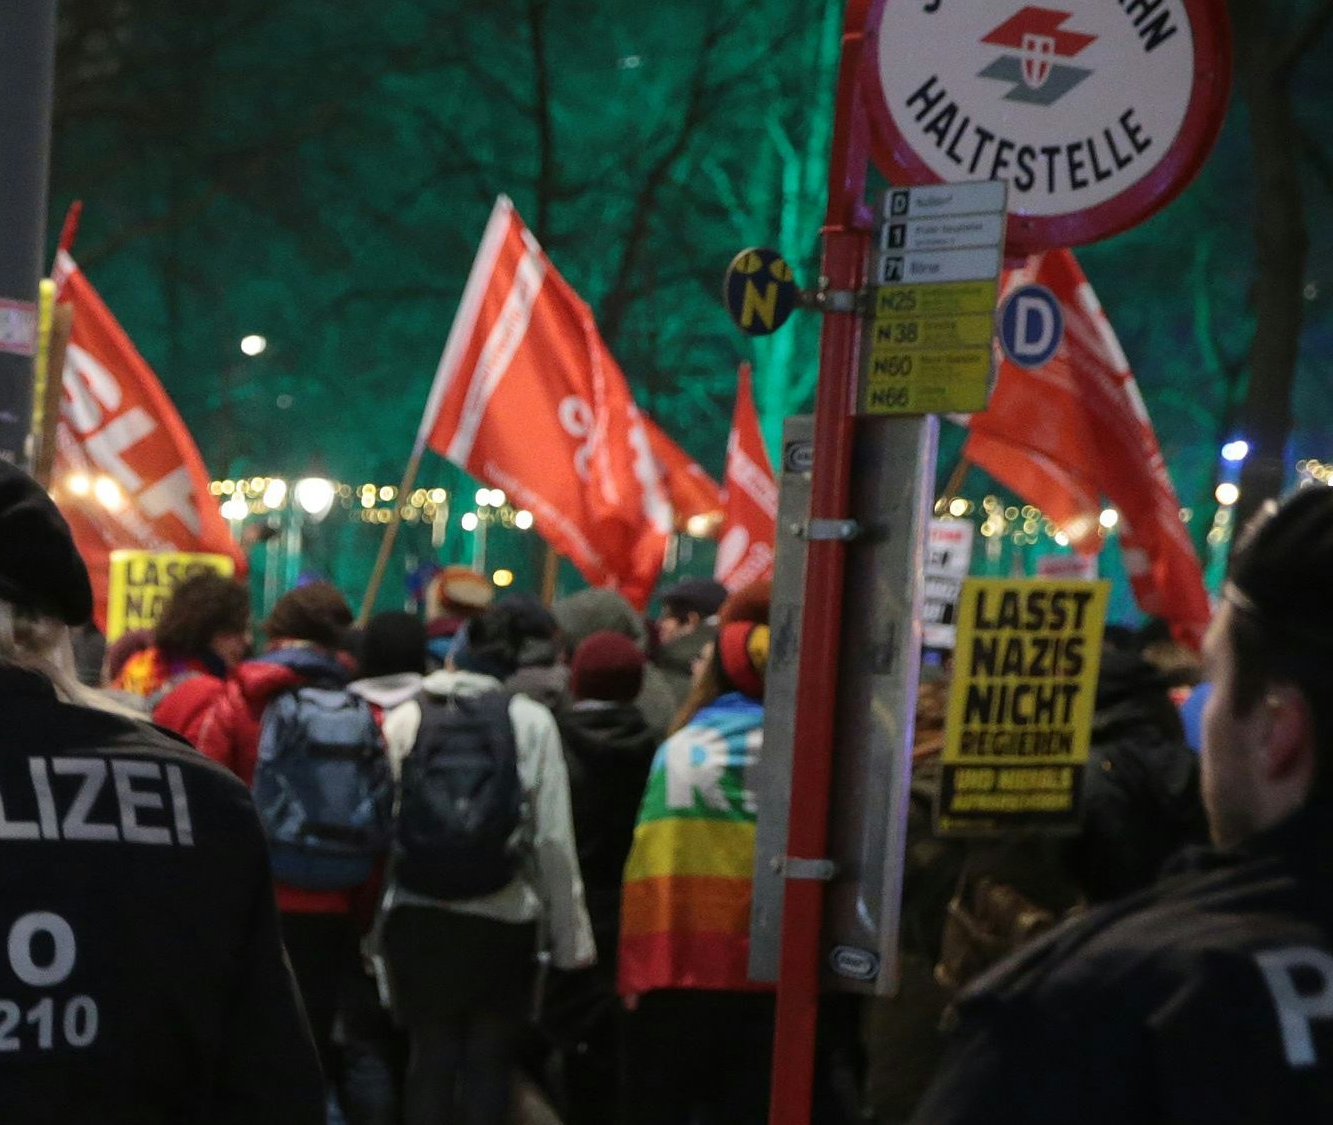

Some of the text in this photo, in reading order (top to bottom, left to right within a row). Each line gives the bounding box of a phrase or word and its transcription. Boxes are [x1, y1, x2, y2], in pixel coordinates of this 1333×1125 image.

[905, 74, 1153, 194] HALTESTELLE
[740, 280, 779, 330] N
[1014, 296, 1056, 356] D
[975, 589, 1095, 630] LASST
[970, 637, 1086, 678] NAZIS
[964, 684, 1080, 726] NICHT
